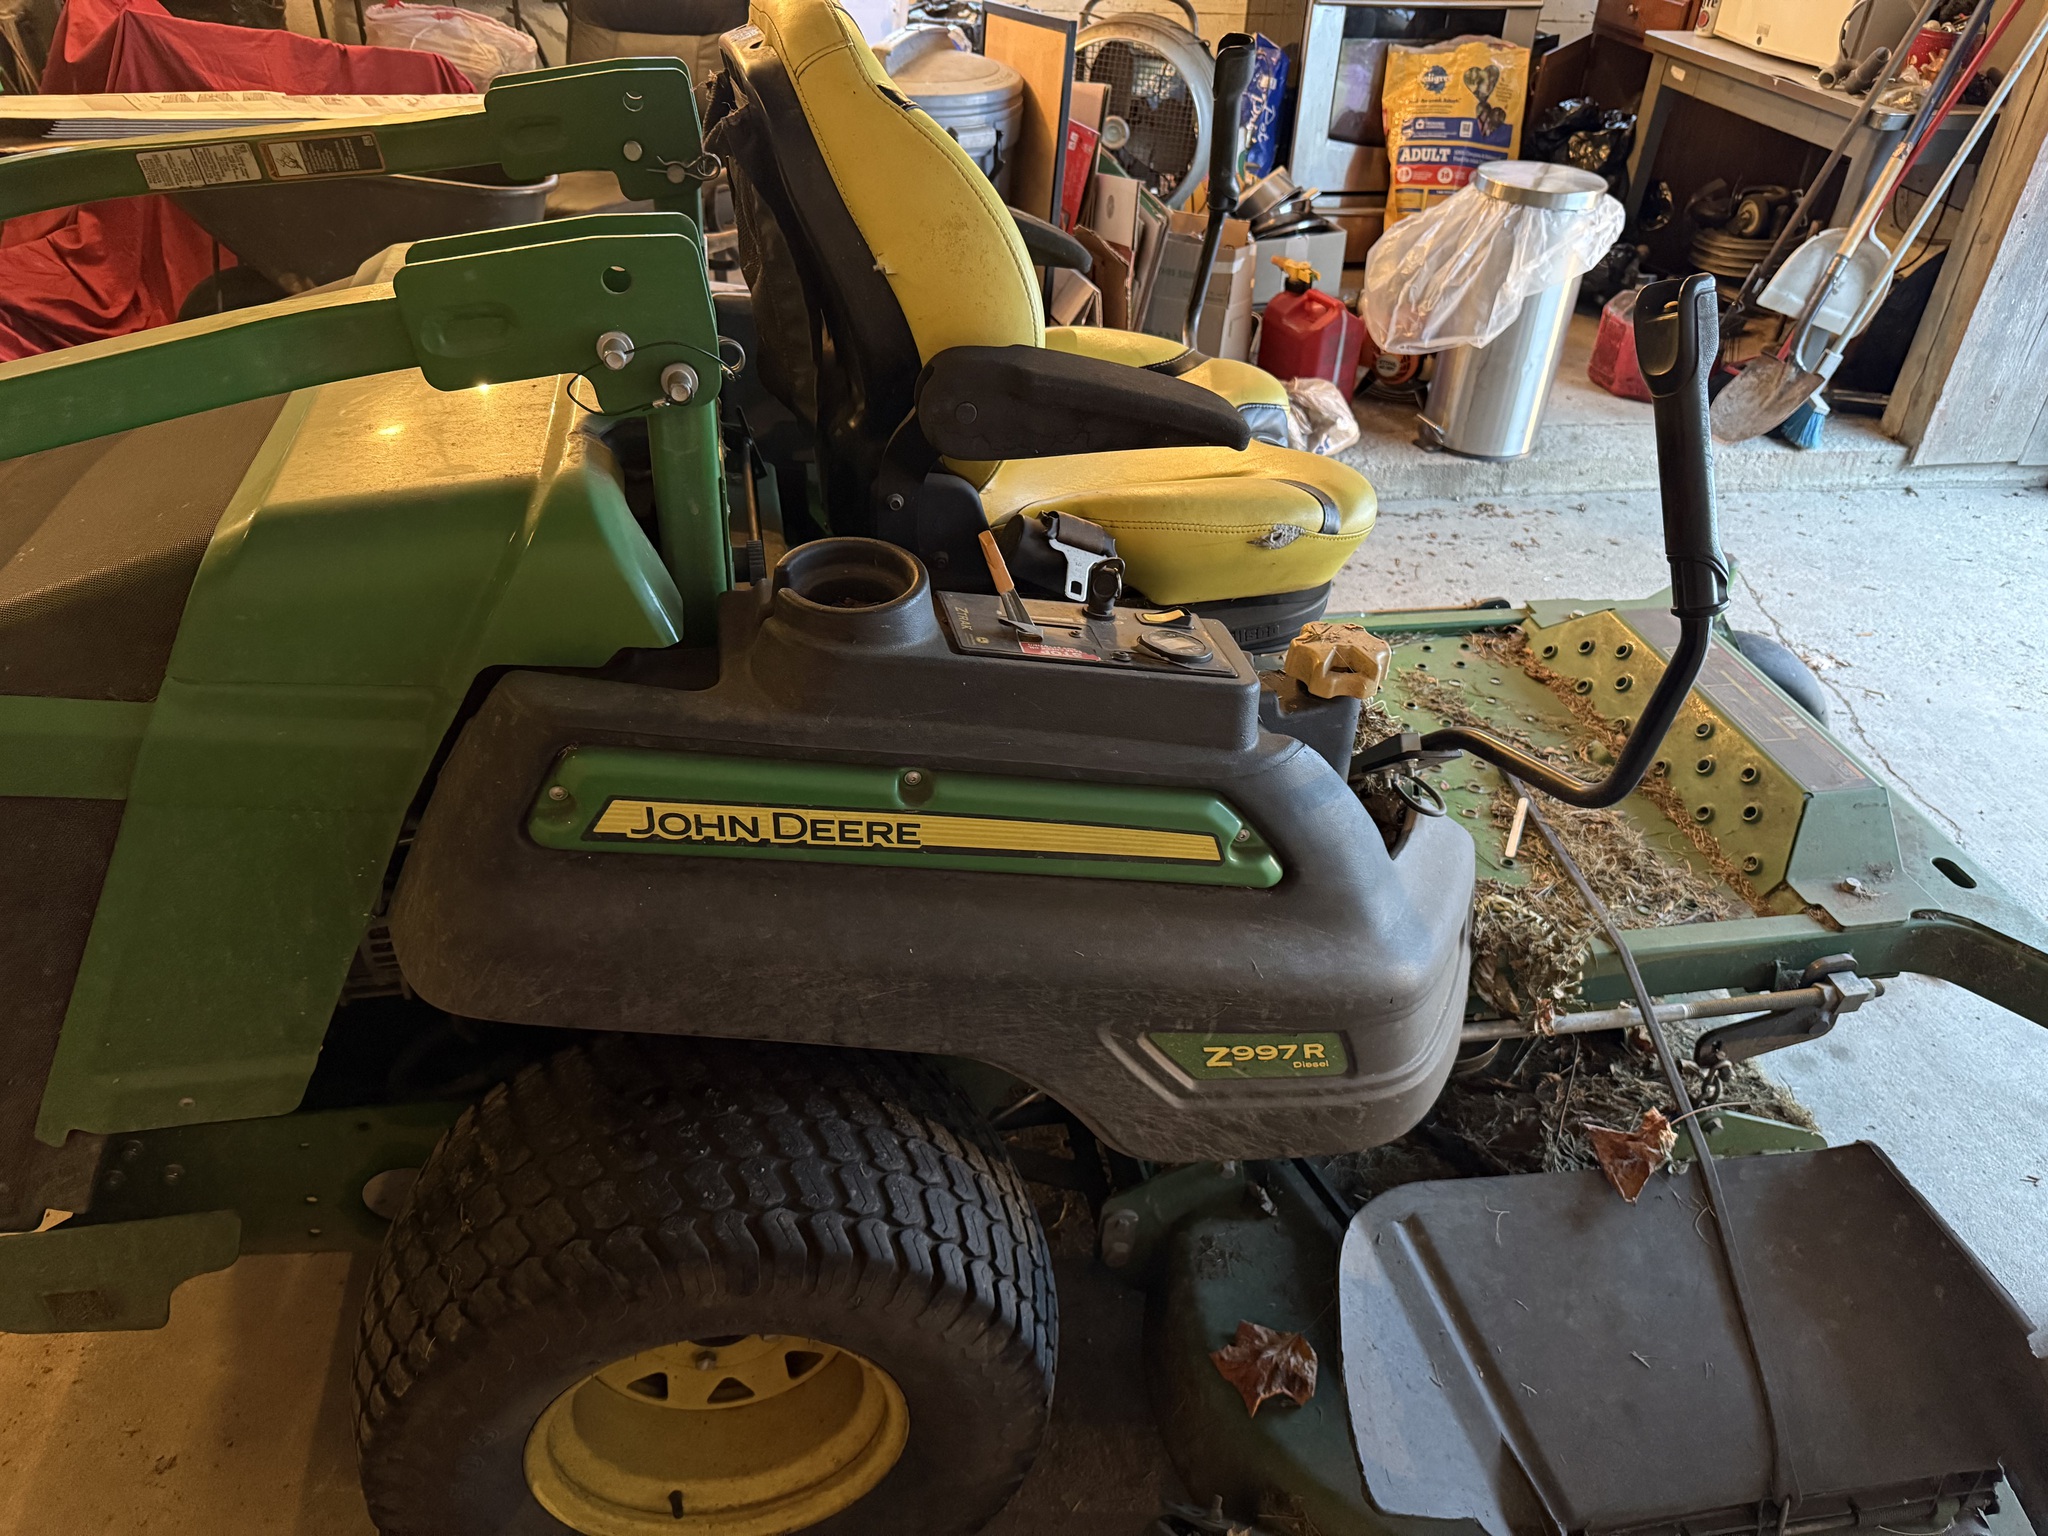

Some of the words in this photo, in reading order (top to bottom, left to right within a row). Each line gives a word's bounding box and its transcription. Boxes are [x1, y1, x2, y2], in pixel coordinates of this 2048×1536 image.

[1399, 147, 1451, 162] ADULT
[629, 806, 760, 838] JOHN
[772, 812, 921, 845] DEERE
[1293, 1059, 1329, 1069] Diesel
